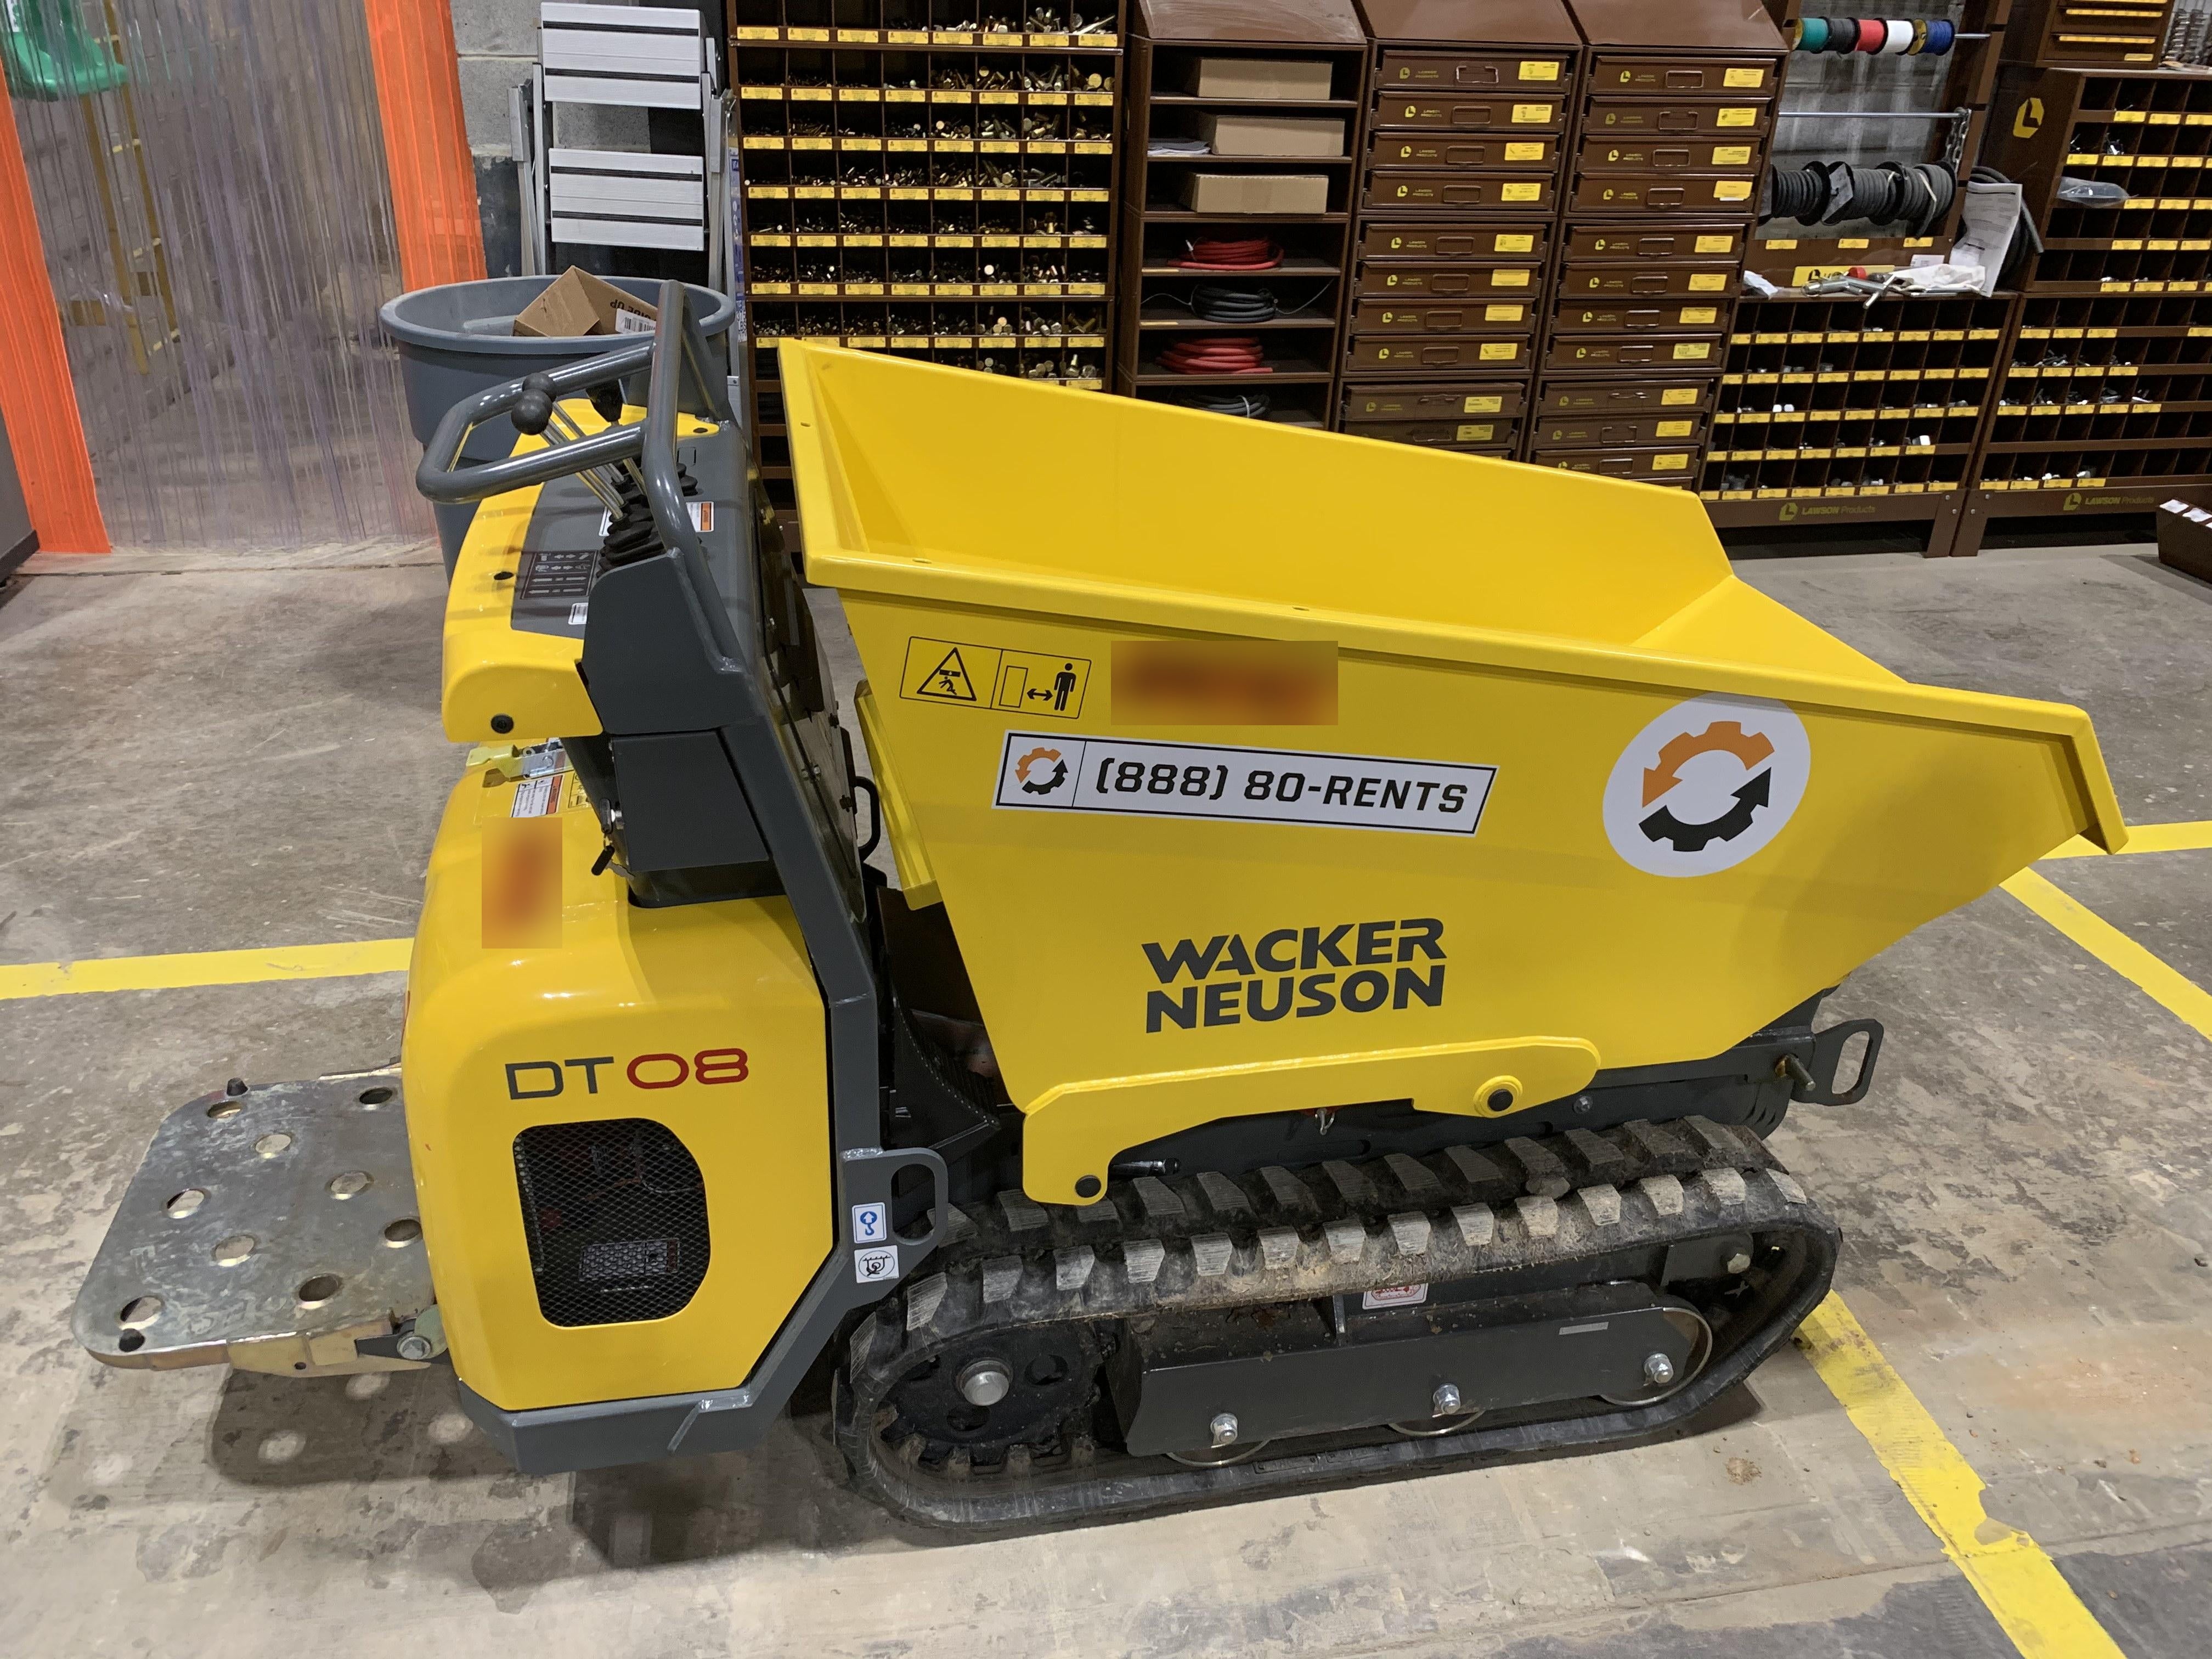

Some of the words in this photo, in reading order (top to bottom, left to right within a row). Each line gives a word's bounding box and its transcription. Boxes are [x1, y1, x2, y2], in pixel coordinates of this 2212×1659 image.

[1096, 758, 1228, 800] (888)
[1244, 770, 1468, 812] 80-RENTS
[1142, 918, 1447, 984] WACKER
[1147, 965, 1445, 1033] NEUSON
